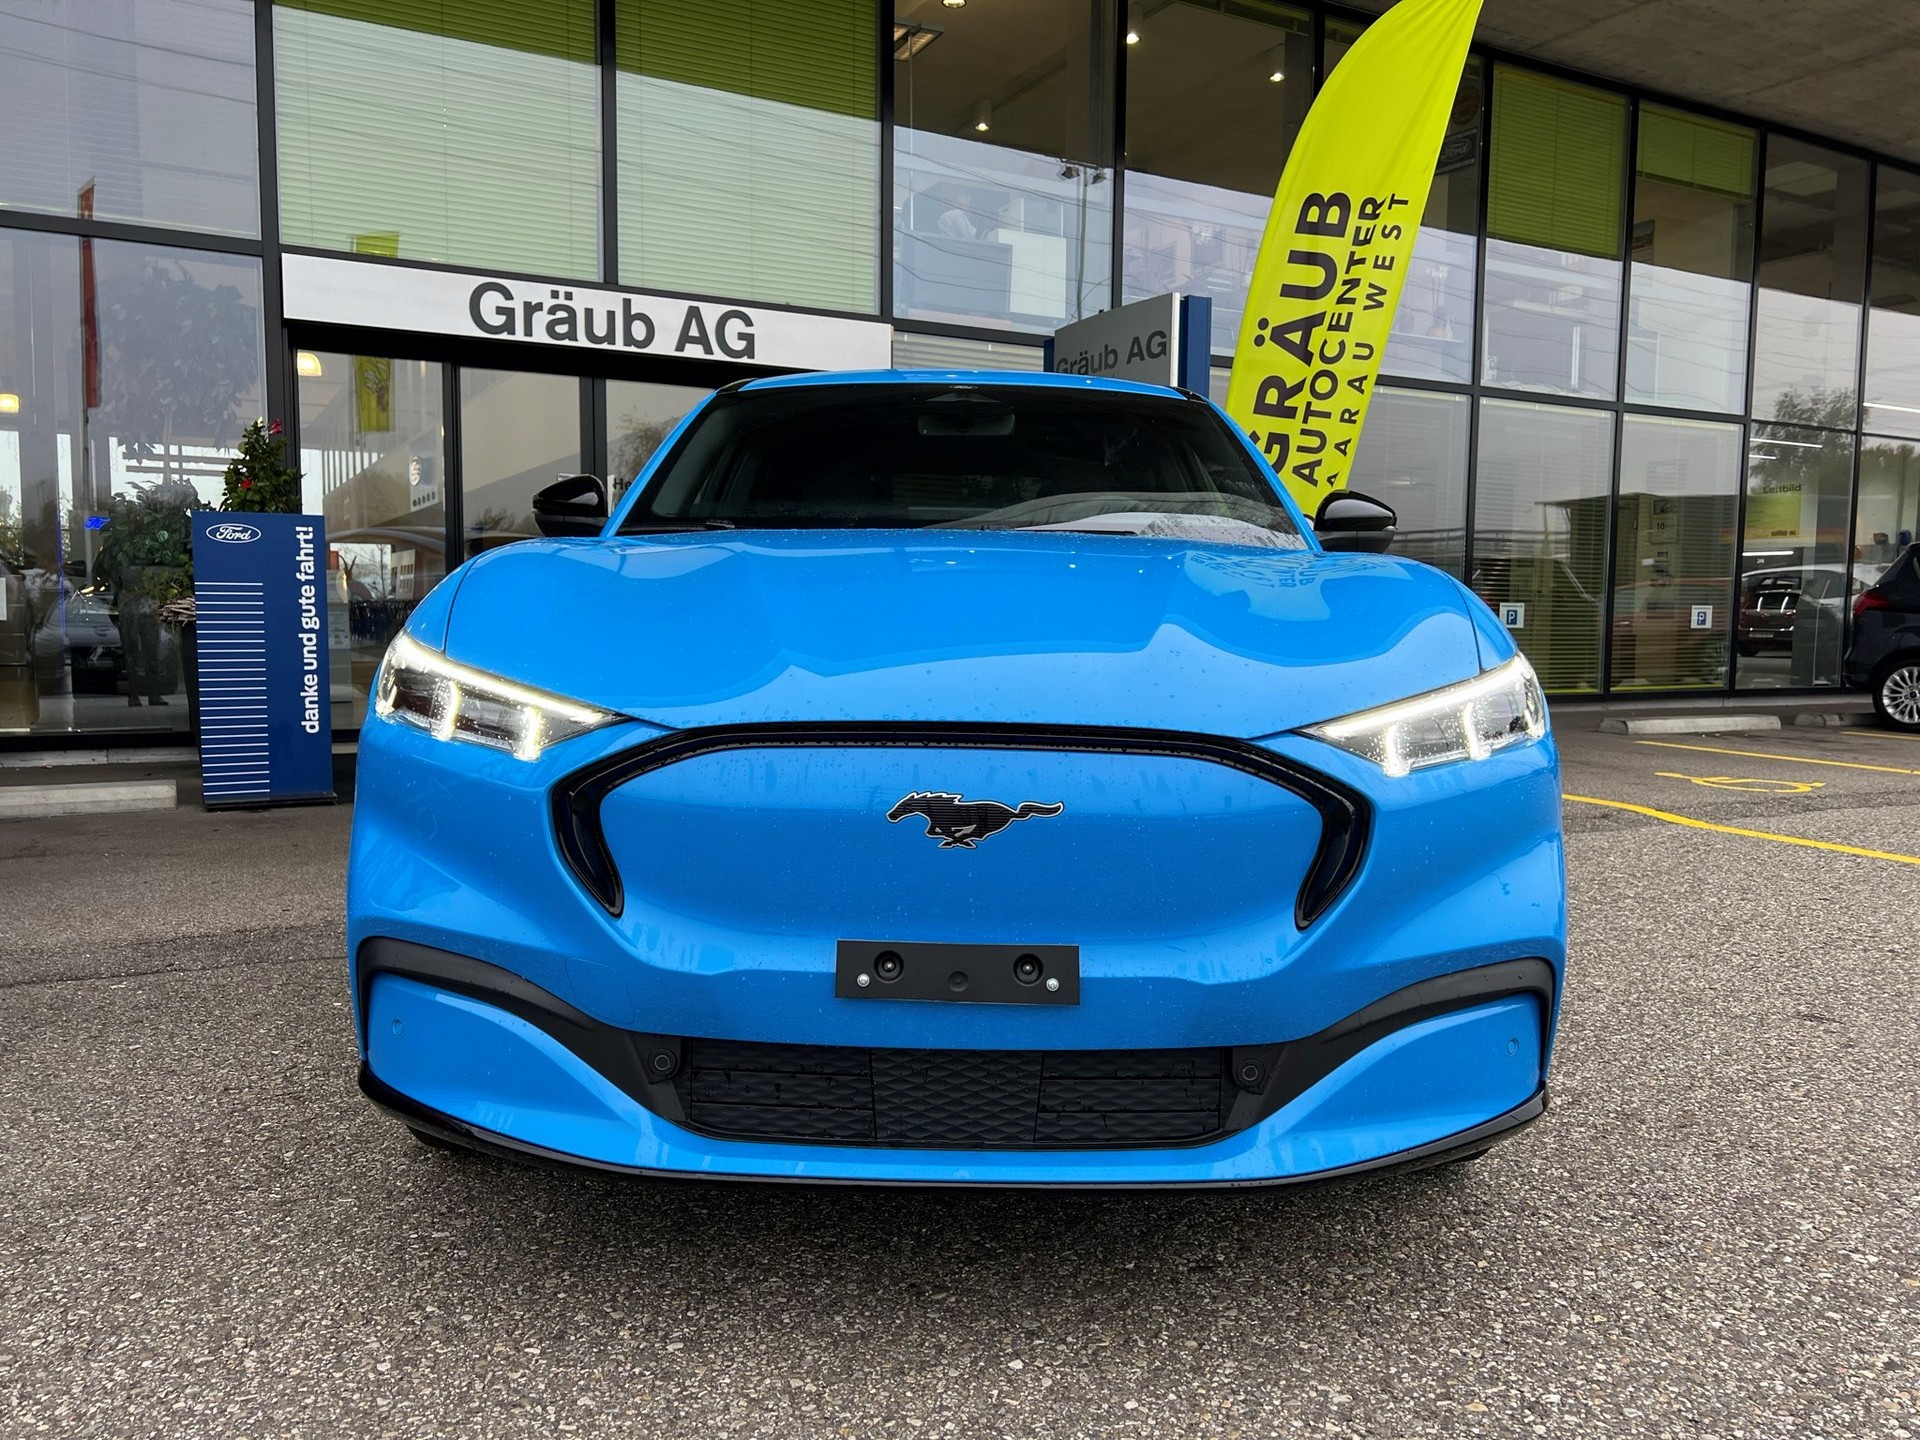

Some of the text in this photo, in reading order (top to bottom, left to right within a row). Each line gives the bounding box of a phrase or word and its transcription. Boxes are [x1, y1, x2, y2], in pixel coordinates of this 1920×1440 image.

[469, 281, 755, 360] Gräub AG
[1056, 330, 1167, 375] Gräub AG
[1249, 192, 1351, 475] GRÄUB
[1291, 196, 1388, 488] AUTOCENTER
[1326, 193, 1409, 487] AARAU WEST
[216, 525, 252, 540] Ford
[296, 526, 320, 734] danke und gute fahrt!
